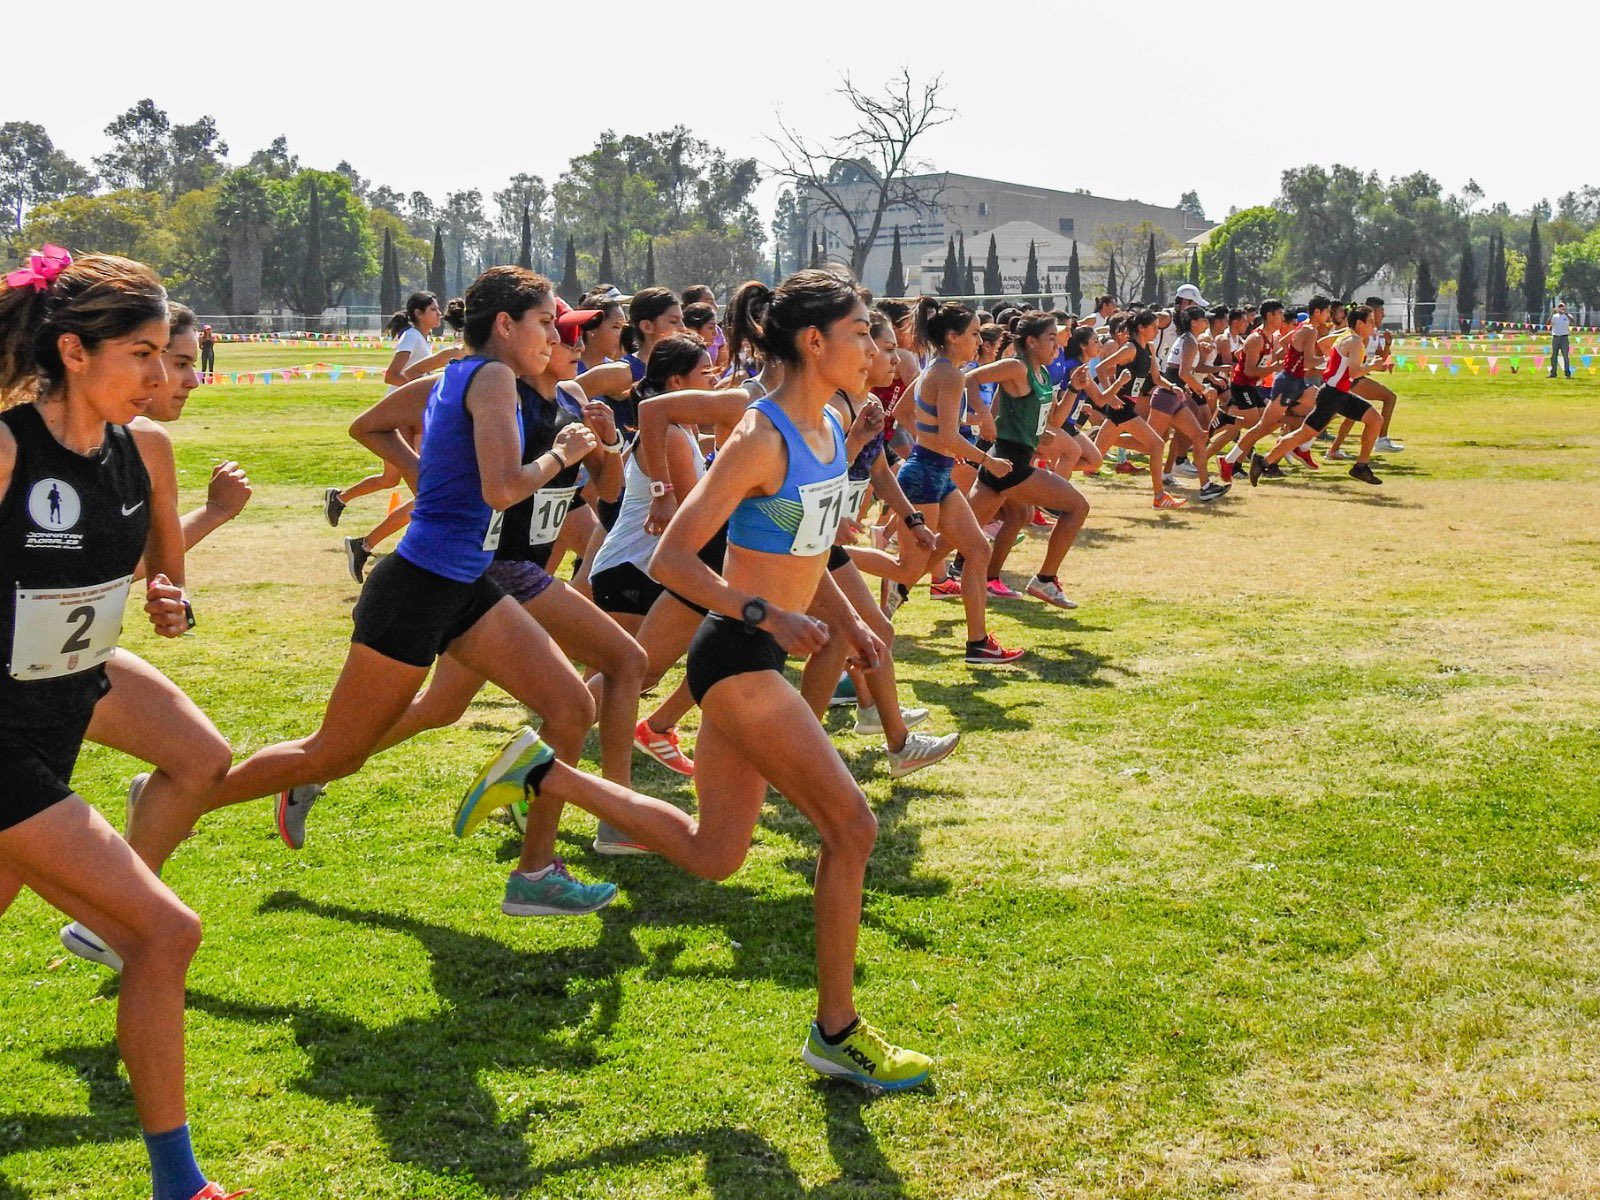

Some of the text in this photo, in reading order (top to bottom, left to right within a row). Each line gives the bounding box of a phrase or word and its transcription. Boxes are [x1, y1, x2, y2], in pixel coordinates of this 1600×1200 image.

[1133, 382, 1141, 392] 2
[538, 499, 568, 530] 10
[818, 490, 843, 536] 71
[60, 605, 96, 655] 2
[842, 1044, 877, 1075] HOKA
